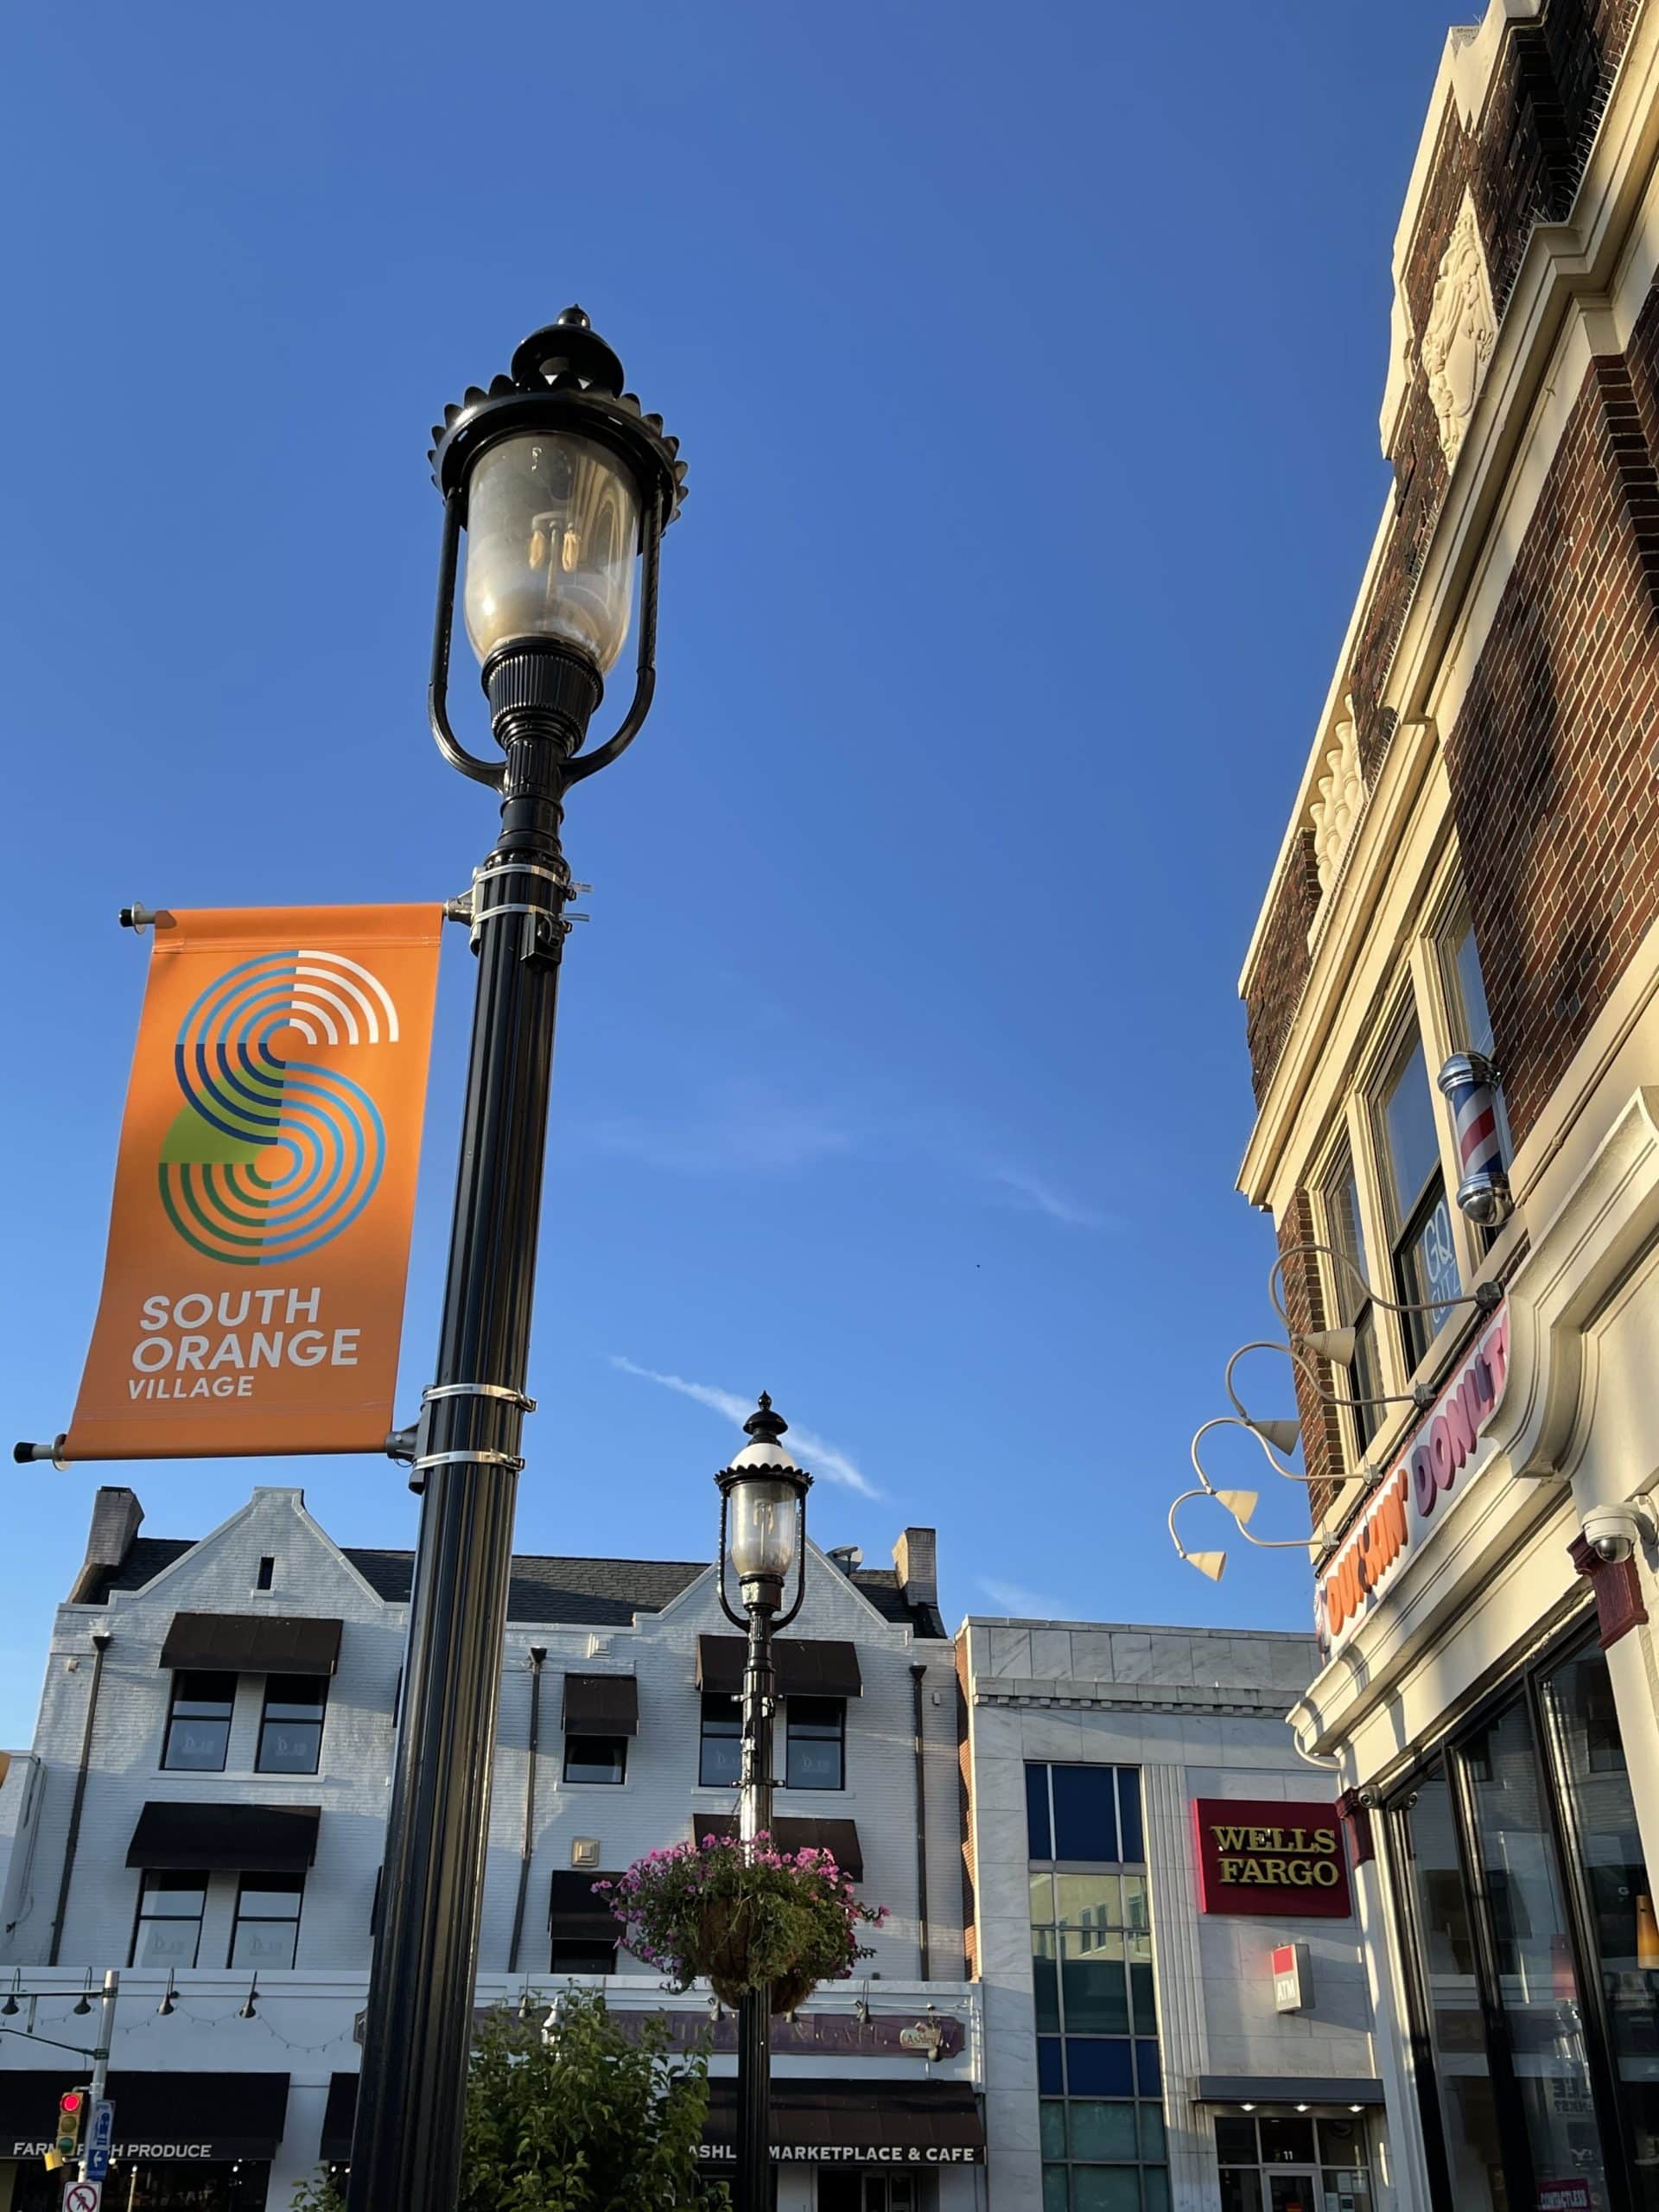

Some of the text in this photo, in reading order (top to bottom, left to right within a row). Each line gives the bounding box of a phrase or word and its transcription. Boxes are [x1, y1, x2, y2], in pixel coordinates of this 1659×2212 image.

[140, 1287, 321, 1331] SOUTH
[132, 1328, 361, 1373] ORANGE
[129, 1376, 254, 1399] VILLAGE
[1211, 1826, 1338, 1853] WELLS
[1217, 1858, 1339, 1886] FARGO
[1276, 1979, 1296, 2002] ATM
[126, 2144, 212, 2158] PRODUCE
[769, 2145, 902, 2161] MARKETPLACE
[908, 2147, 920, 2161] &
[925, 2148, 974, 2162] CAFE
[1283, 2151, 1294, 2160] 11
